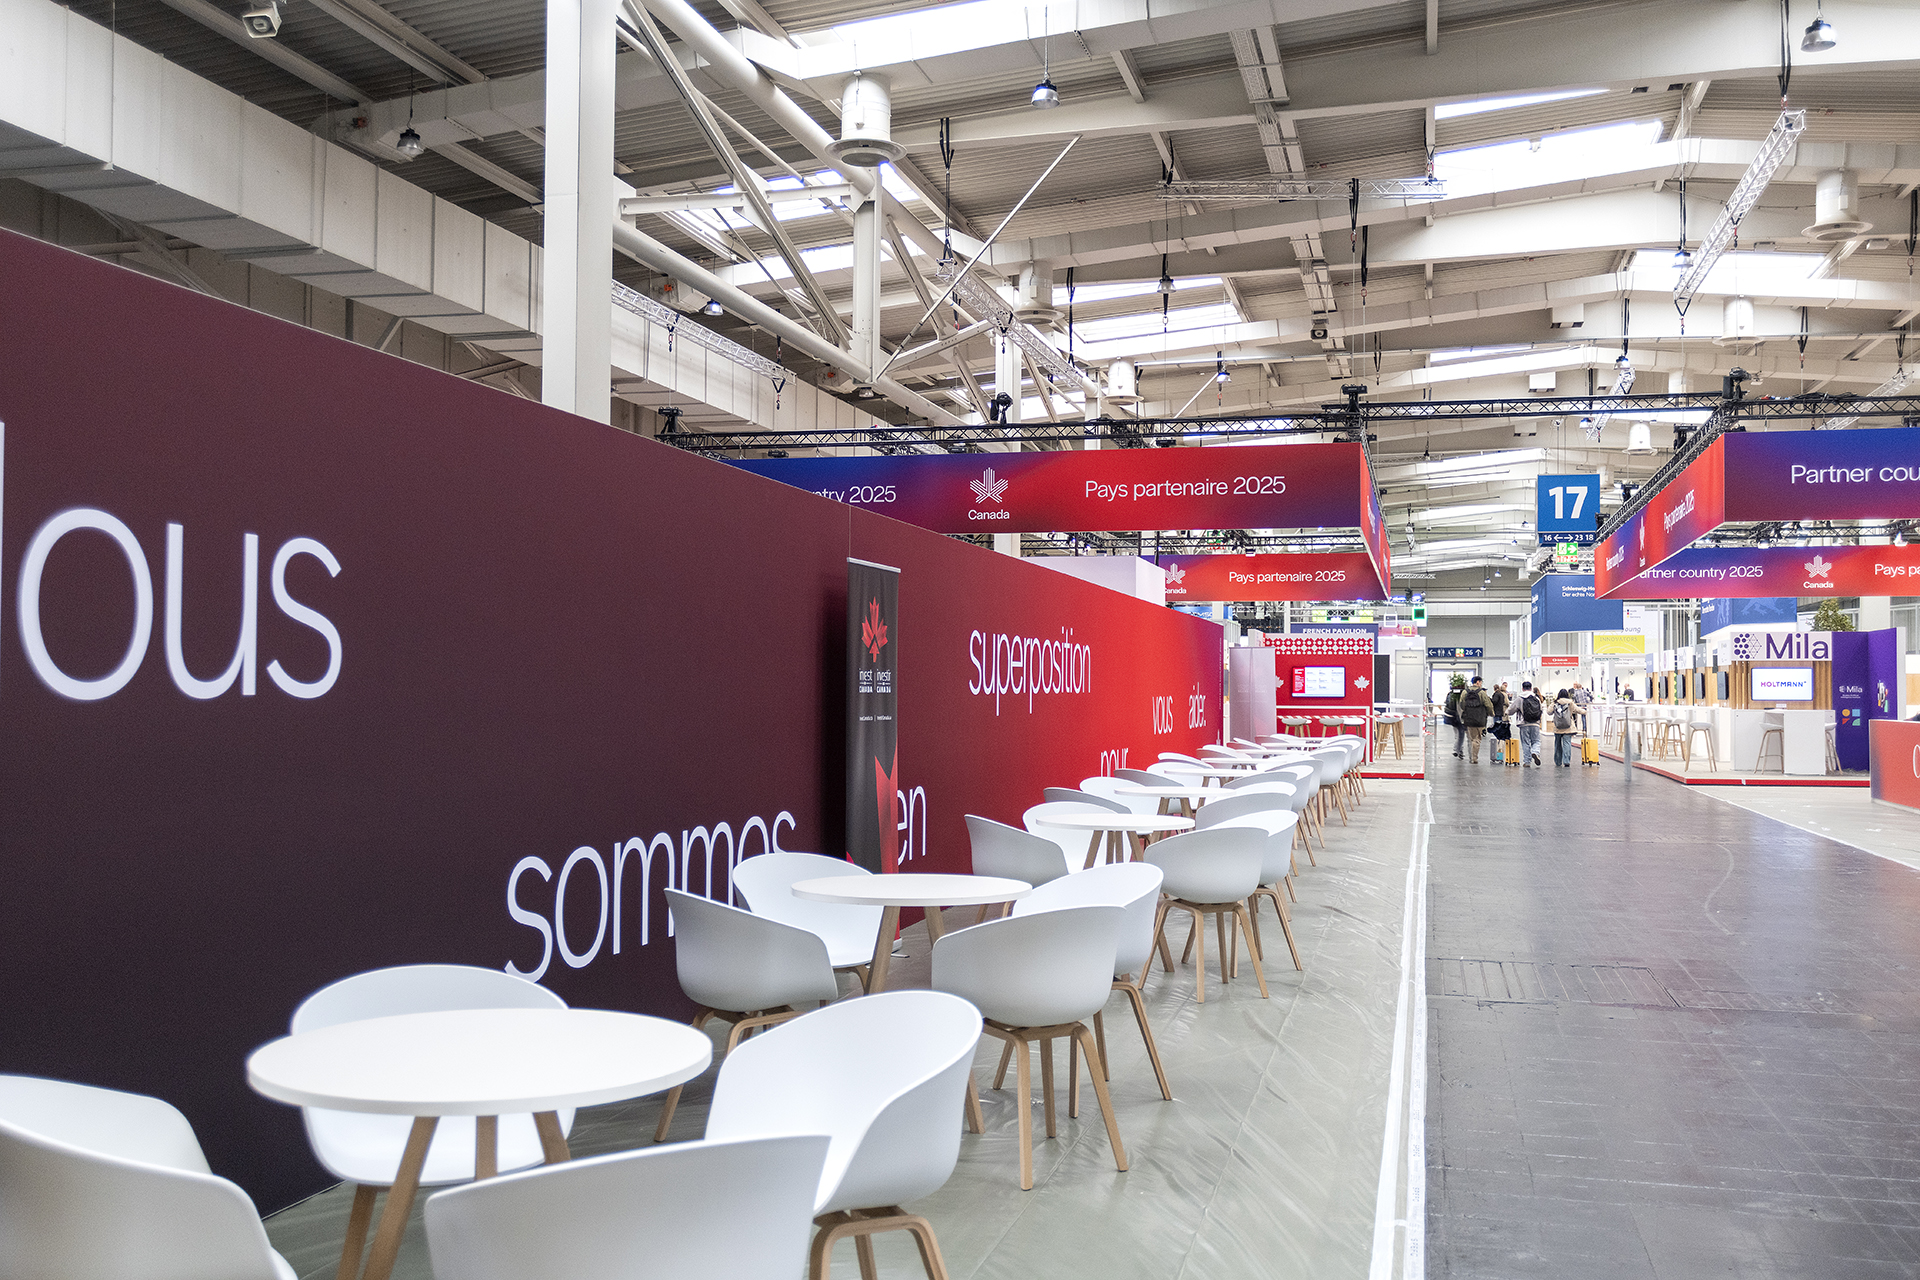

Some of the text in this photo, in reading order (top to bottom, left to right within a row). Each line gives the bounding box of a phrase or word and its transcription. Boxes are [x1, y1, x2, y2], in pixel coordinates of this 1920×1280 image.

[1791, 464, 1920, 484] Partner cou
[849, 485, 897, 503] 2025
[1085, 475, 1287, 502] Pays partenaire 2025
[1548, 486, 1588, 519] 17
[967, 508, 1010, 521] Canada
[1585, 533, 1594, 541] 18
[0, 421, 343, 701] ous
[1228, 570, 1346, 585] Pays partenaire 2025
[1678, 567, 1726, 581] country
[1728, 565, 1764, 578] 2025
[1874, 563, 1906, 578] Pays
[1803, 581, 1834, 589] Canada
[1765, 633, 1829, 659] Mila
[968, 626, 1091, 717] superposition
[1846, 685, 1863, 693] Mila
[1152, 696, 1173, 735] vous
